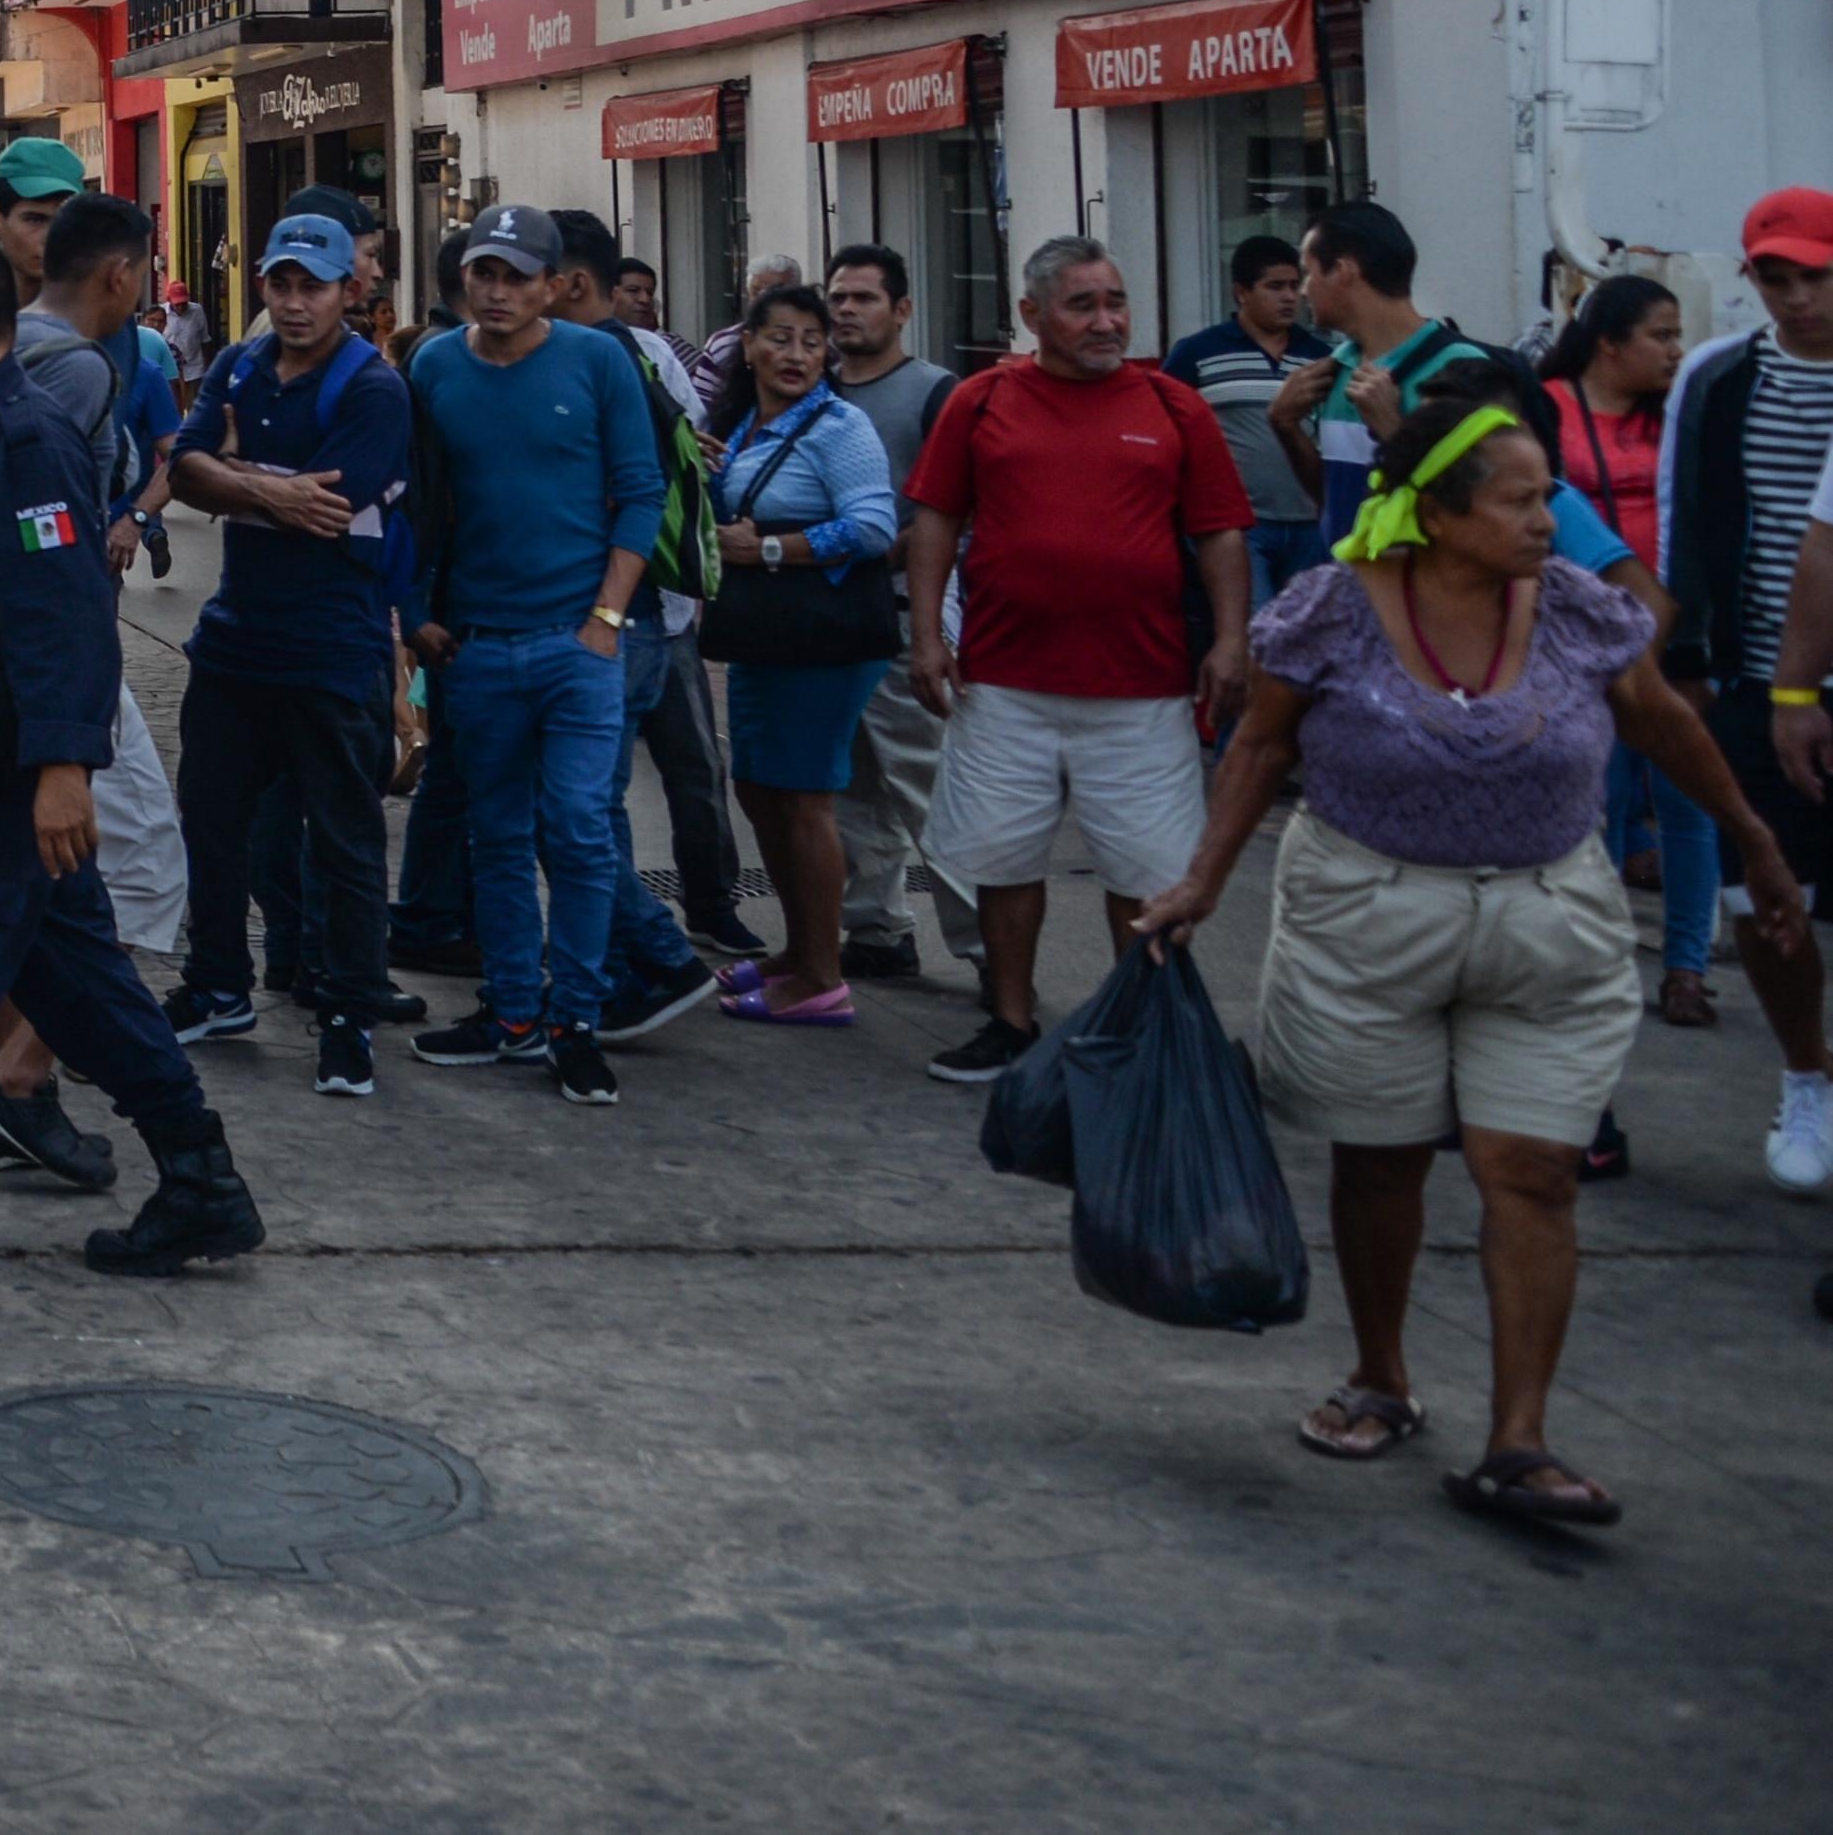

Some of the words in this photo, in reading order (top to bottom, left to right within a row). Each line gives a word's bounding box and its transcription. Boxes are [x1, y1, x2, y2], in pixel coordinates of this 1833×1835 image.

[459, 21, 496, 66] Vende
[527, 9, 572, 62] Aparta
[1086, 43, 1162, 91] VENDE
[1187, 24, 1293, 81] APARTA
[817, 83, 873, 128] EMPEÑA
[885, 70, 955, 117] COMPRA
[614, 118, 664, 149] SOLUCIONES
[664, 119, 678, 142] EN
[677, 114, 713, 142] DINERO
[15, 500, 68, 521] MEXICO
